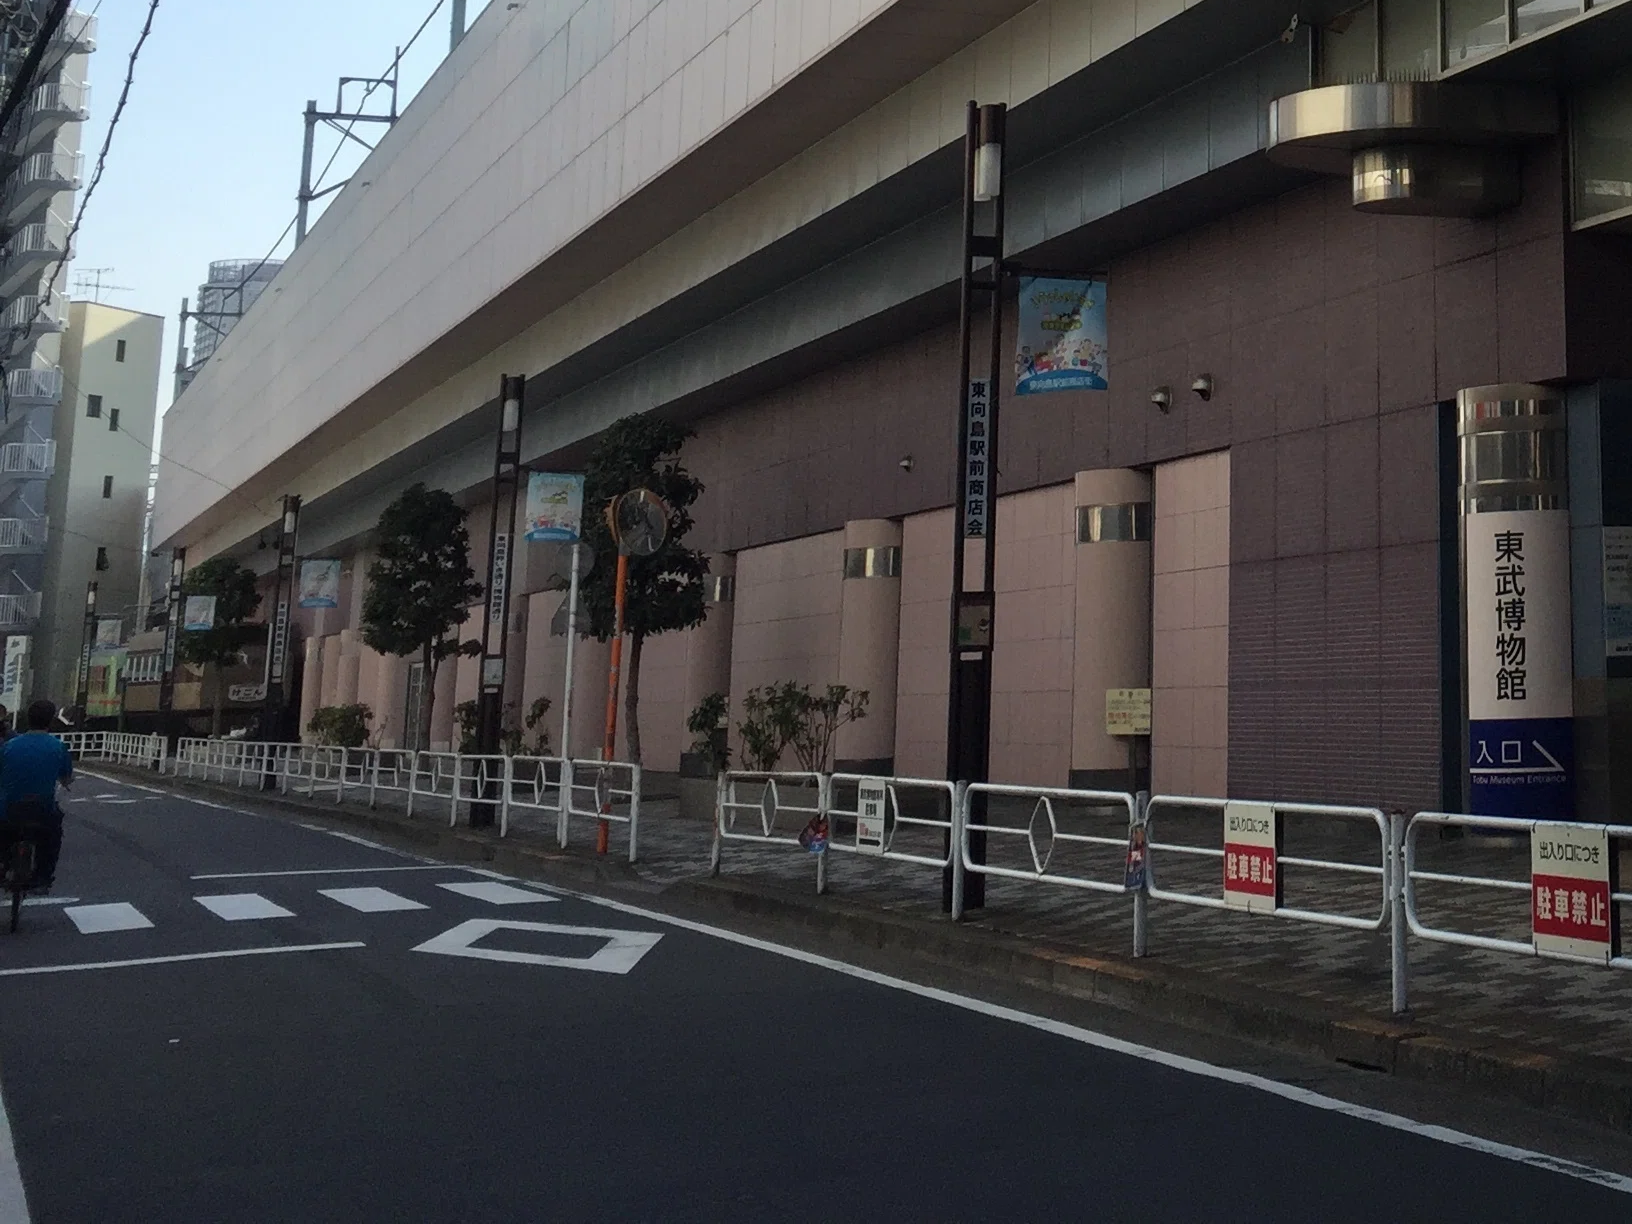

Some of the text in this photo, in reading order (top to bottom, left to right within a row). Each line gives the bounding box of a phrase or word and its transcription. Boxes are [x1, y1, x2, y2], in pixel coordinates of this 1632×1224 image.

[968, 382, 987, 536] 東向島駅前商店会
[1494, 530, 1527, 701] 東武博物館
[1476, 739, 1522, 764] 入口
[1472, 773, 1567, 784] Tobu Museum Entrance
[1229, 816, 1269, 834] 出入り口につき
[1539, 841, 1600, 864] 出入り口につき
[1227, 852, 1273, 884] 駐車禁止
[1536, 886, 1607, 927] 駐車禁止
